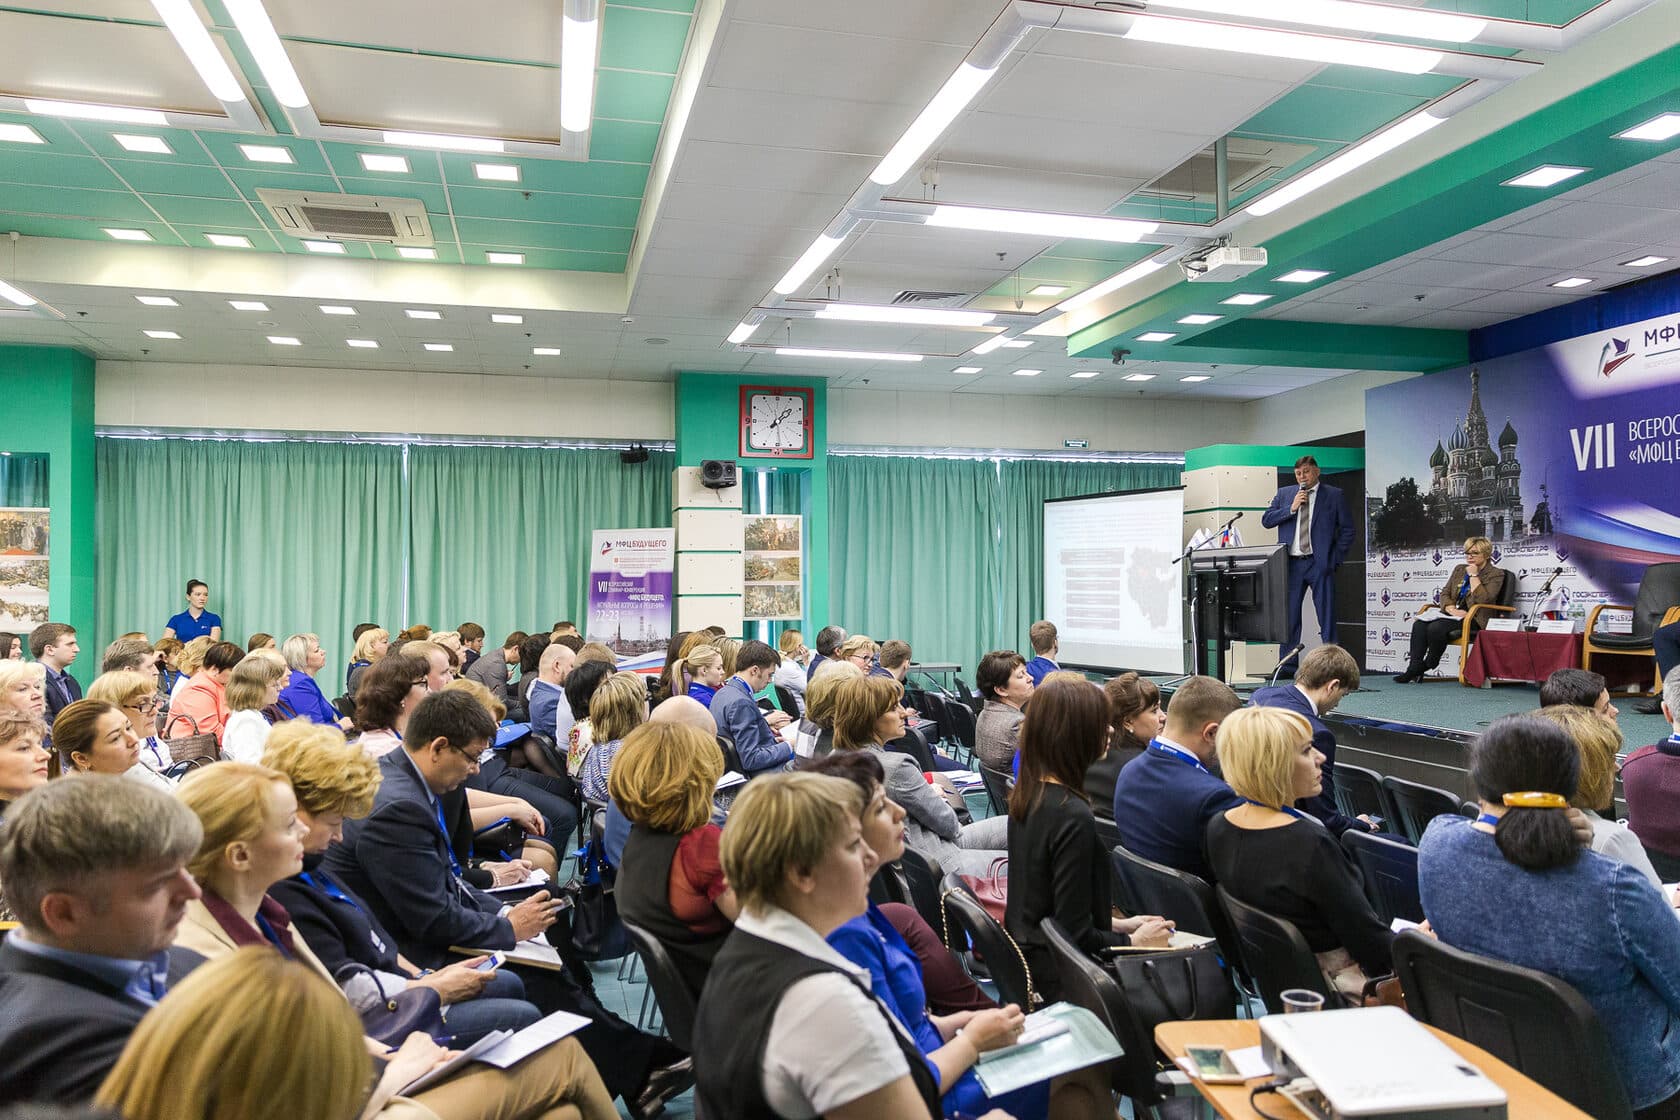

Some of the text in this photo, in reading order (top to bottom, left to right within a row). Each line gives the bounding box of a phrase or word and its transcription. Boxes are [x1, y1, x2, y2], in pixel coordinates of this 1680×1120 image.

[1644, 322, 1680, 347] МФ
[1628, 413, 1680, 441] ВСЕРОС
[1568, 423, 1616, 472] VII
[1628, 440, 1673, 465] «МФЦ
[615, 539, 667, 549] МФЦБУДУЩЕГО
